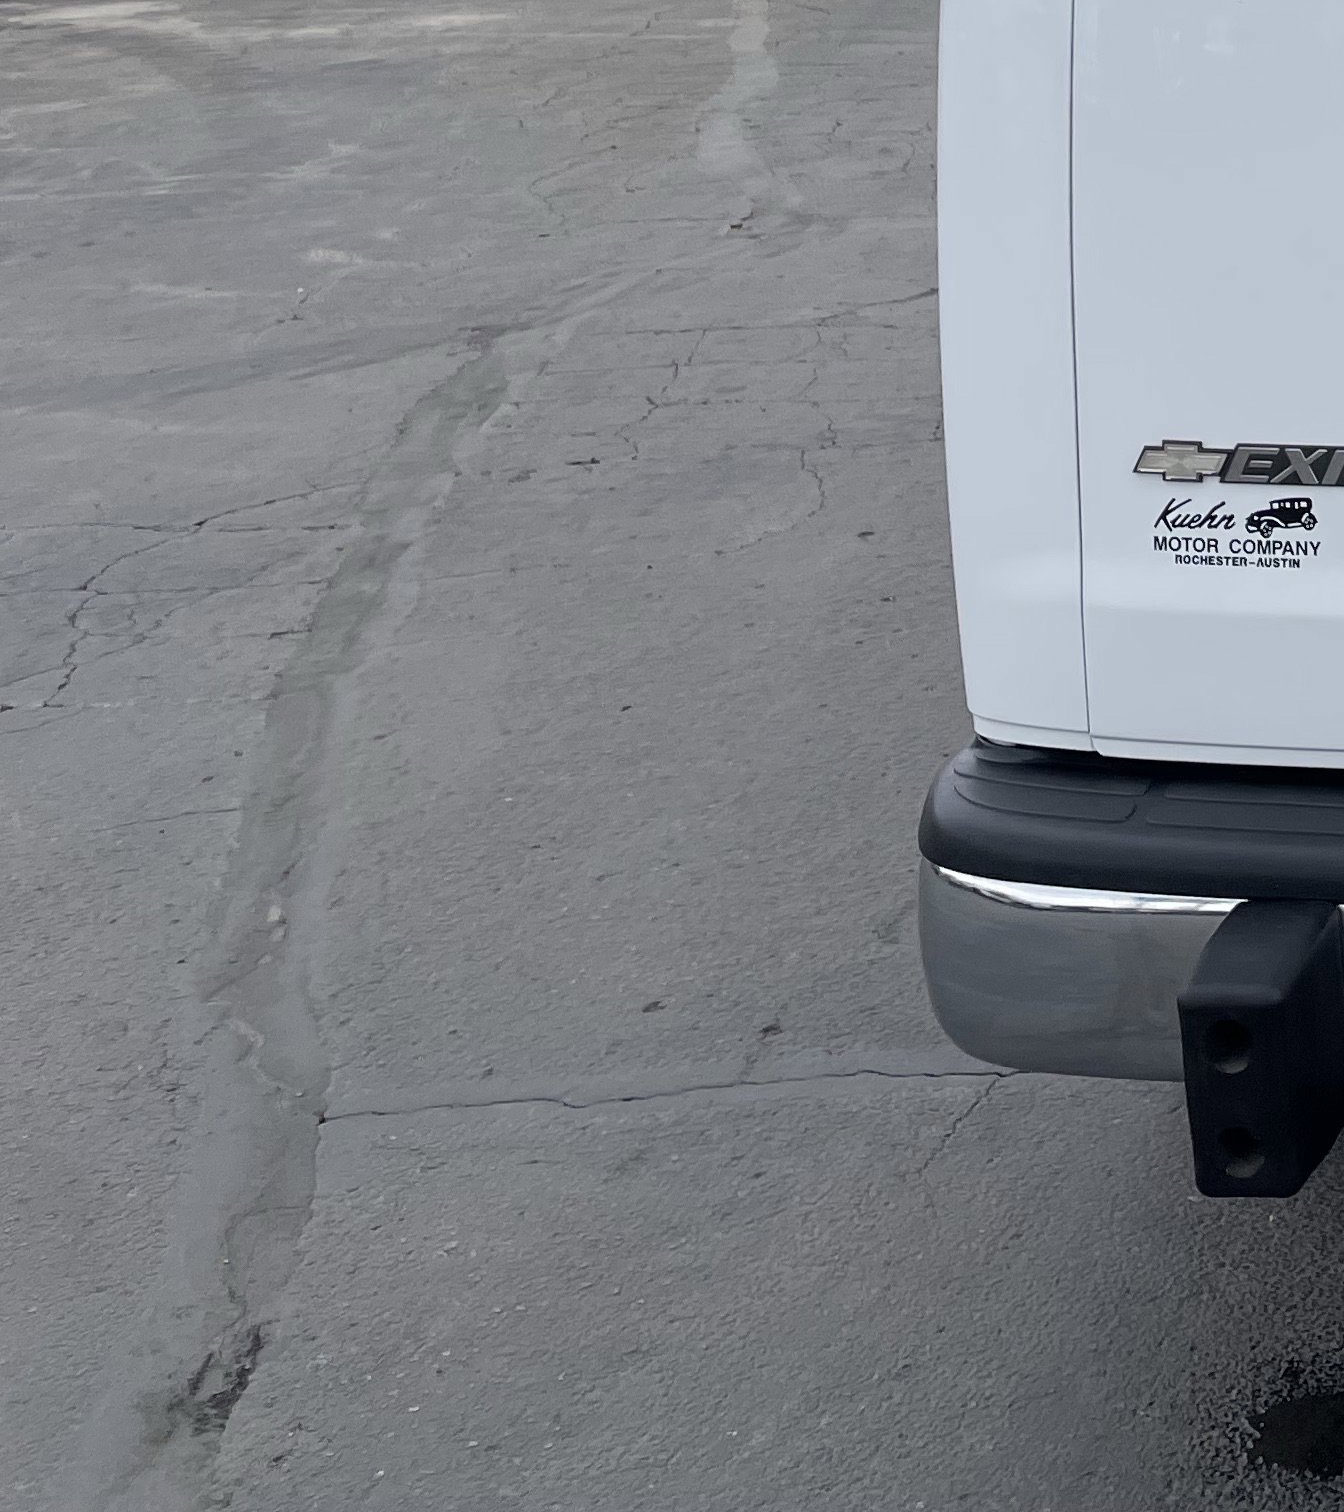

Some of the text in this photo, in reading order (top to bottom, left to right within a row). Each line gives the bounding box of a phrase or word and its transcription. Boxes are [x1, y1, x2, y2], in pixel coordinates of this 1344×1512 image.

[1153, 497, 1238, 532] Kuehn
[1153, 535, 1322, 557] MOTOR COMPANY
